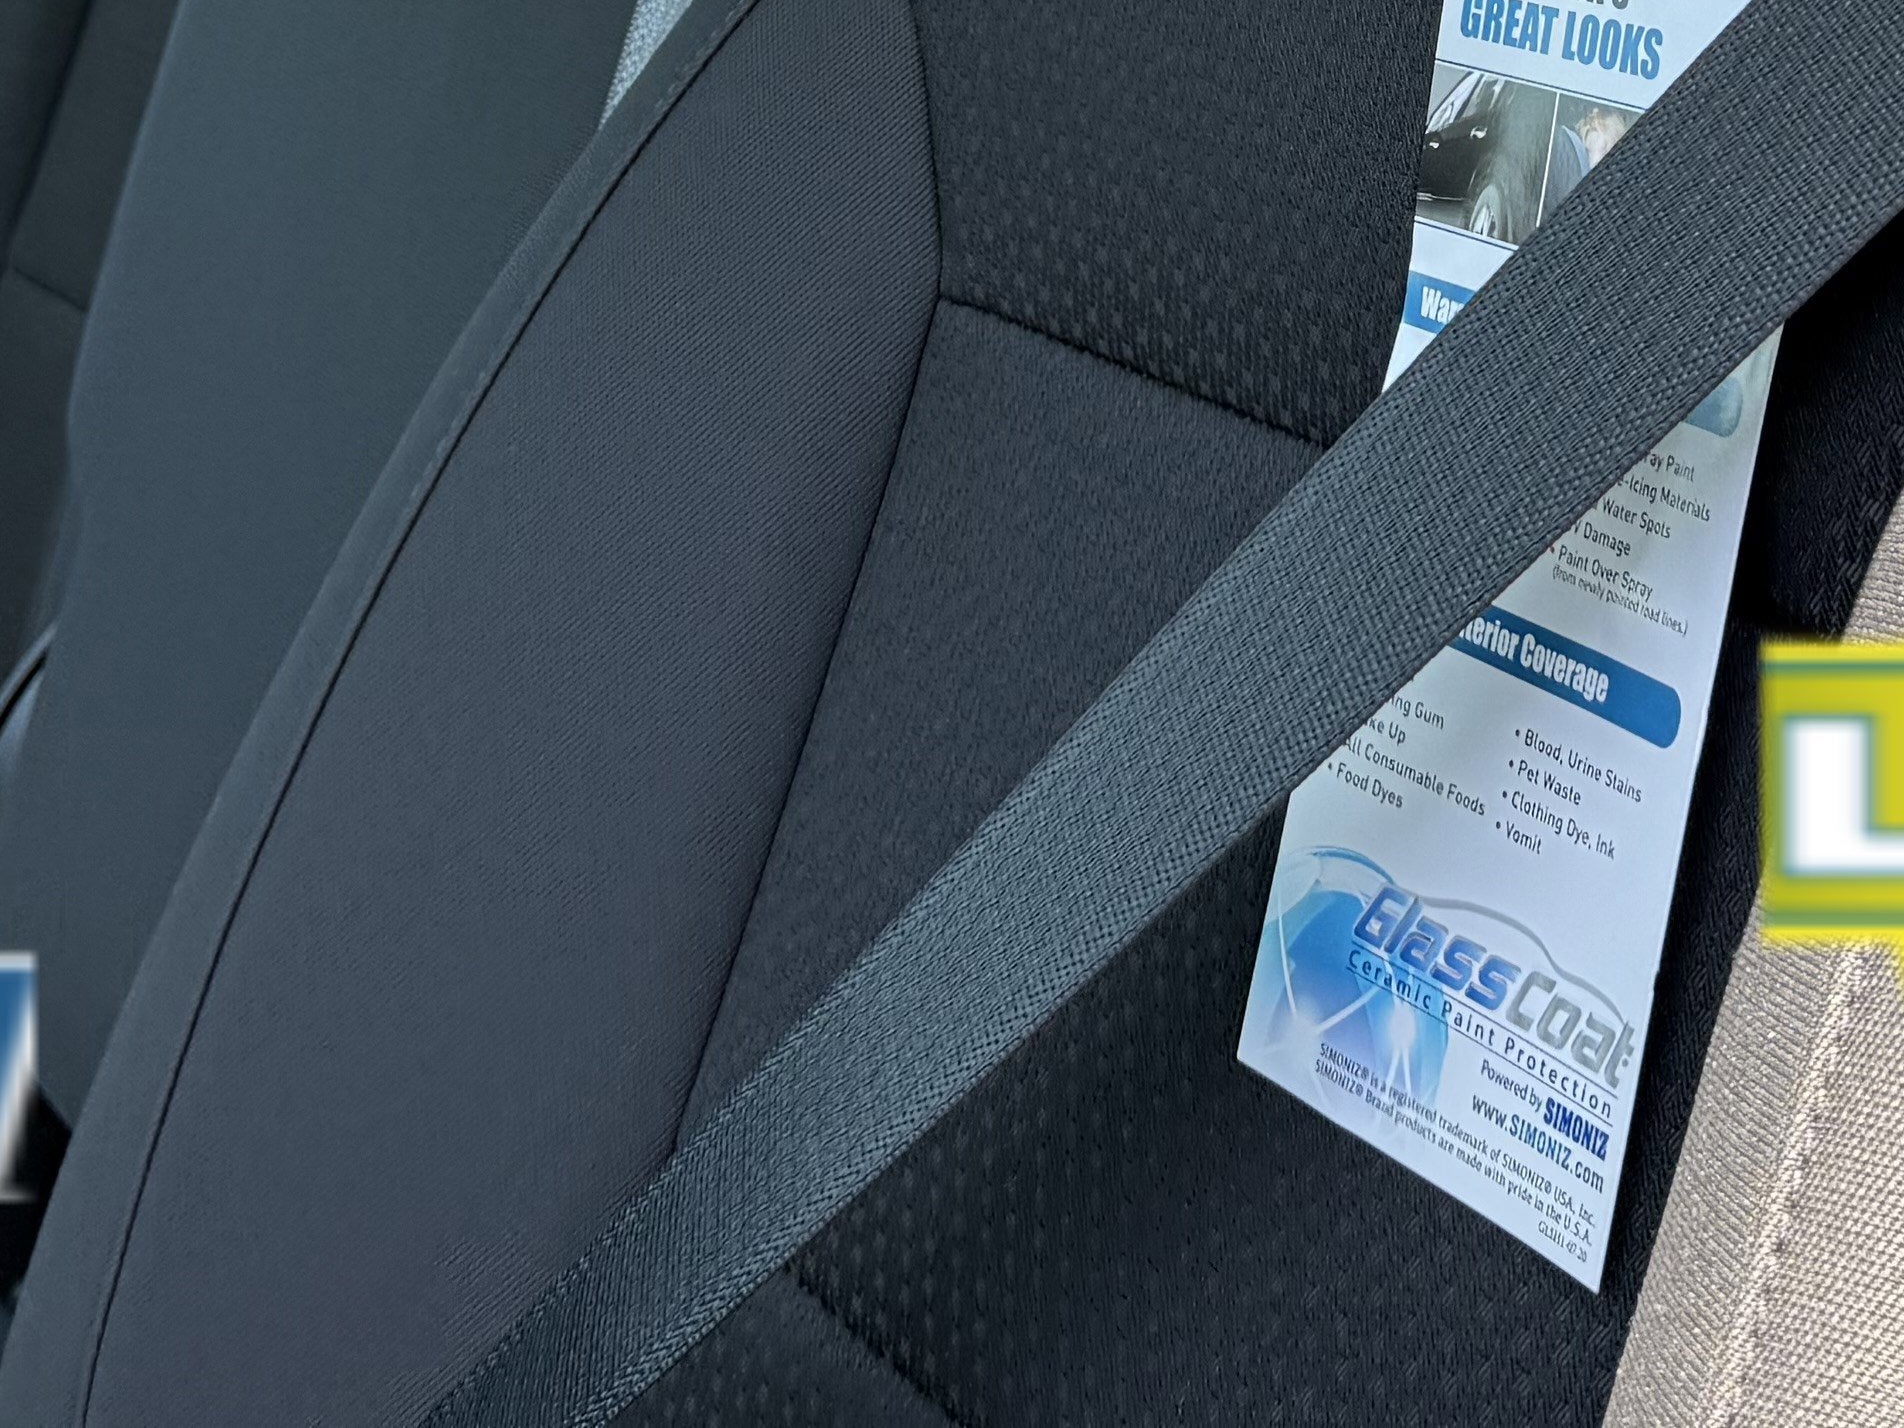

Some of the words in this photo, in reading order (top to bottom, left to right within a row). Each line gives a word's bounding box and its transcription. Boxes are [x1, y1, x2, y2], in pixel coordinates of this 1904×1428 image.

[1562, 10, 1663, 80] LOOKS
[1666, 455, 1696, 482] Paint
[1603, 497, 1637, 525] Water
[1640, 511, 1671, 539] Spots
[1660, 486, 1711, 522] Materials
[1583, 522, 1631, 557] Damage
[1558, 544, 1589, 572] Paint
[1591, 559, 1620, 583] Over
[1621, 570, 1653, 602] Spray
[1520, 633, 1610, 703] Coverage
[1388, 721, 1406, 745] Up
[1415, 701, 1444, 729] Gum
[1336, 761, 1370, 792] Food
[1371, 778, 1404, 809] Dyes
[1364, 743, 1444, 796] Consumable
[1447, 782, 1486, 817] Foods
[1517, 759, 1540, 786] Pet
[1543, 772, 1582, 806] Waste
[1525, 728, 1563, 766] Blood,
[1567, 749, 1602, 782] Urine
[1605, 768, 1642, 803] Stains
[1506, 820, 1542, 855] Vomit
[1511, 791, 1564, 835] Clothing
[1566, 818, 1593, 850] Dye,
[1595, 834, 1617, 861] Ink
[1353, 887, 1636, 1090] GlassCoat
[1348, 949, 1432, 1011] Ceramic
[1441, 998, 1496, 1044] Paint
[1504, 1036, 1613, 1120] Protection
[1481, 1059, 1529, 1102] Powered
[1529, 1087, 1545, 1113] by
[1543, 1097, 1610, 1162] SIMONIZ
[1438, 1114, 1488, 1156] trademark
[1489, 1148, 1502, 1164] of
[1471, 1093, 1605, 1195] www.SIMONIZ.com
[1484, 1163, 1507, 1188] with
